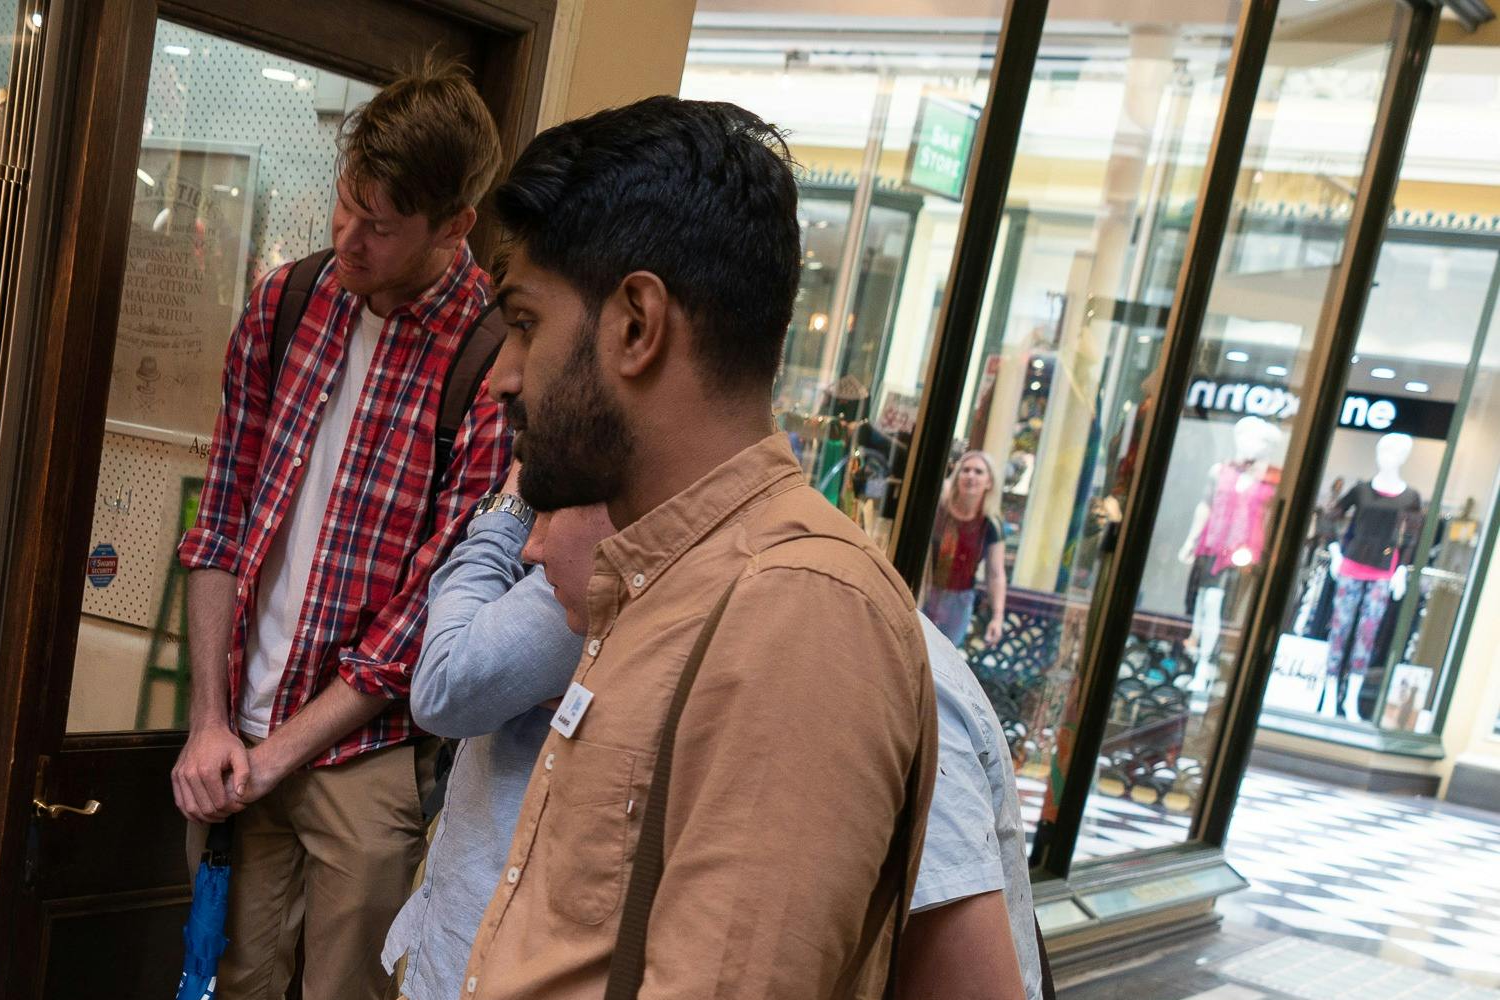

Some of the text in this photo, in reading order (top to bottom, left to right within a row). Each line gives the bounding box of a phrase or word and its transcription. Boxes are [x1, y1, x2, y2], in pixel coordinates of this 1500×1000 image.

[126, 275, 203, 295] RTE CITRON
[124, 289, 186, 306] MACARONS
[121, 303, 194, 323] ABA RHUM
[1340, 396, 1397, 429] ne
